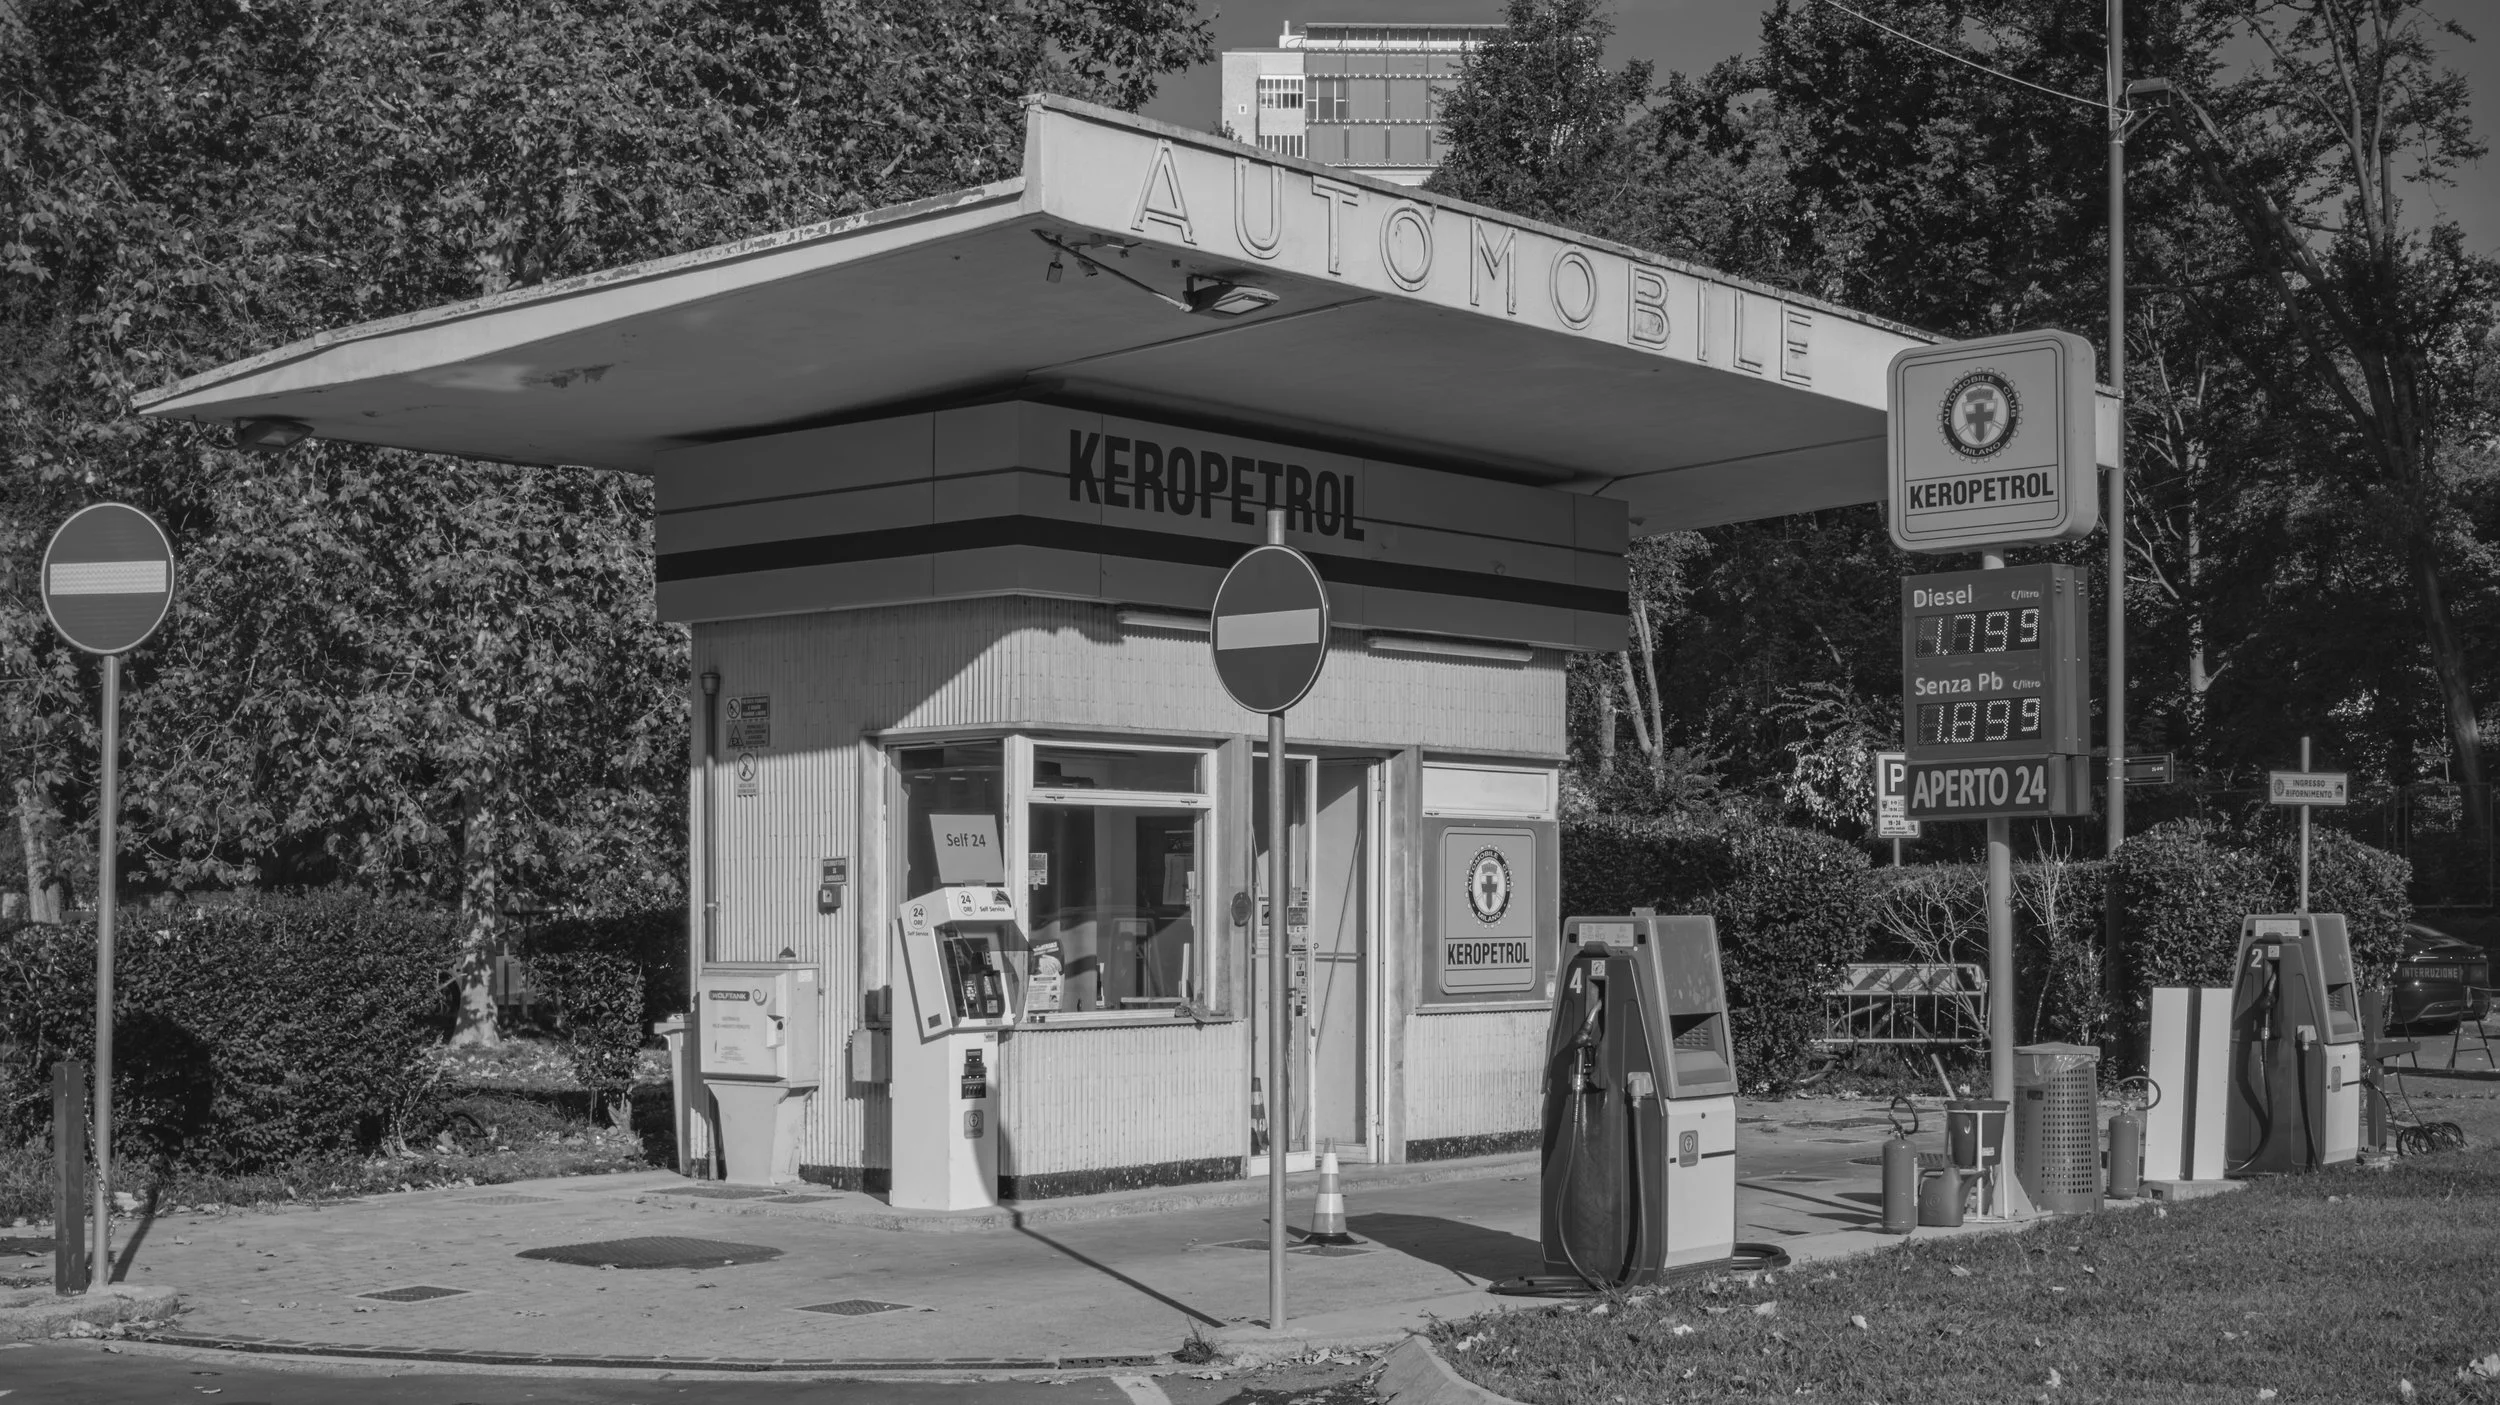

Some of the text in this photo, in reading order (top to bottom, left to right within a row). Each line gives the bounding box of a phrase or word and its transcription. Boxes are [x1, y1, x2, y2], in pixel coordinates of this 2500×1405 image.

[1131, 138, 1815, 387] AUTOMOBILE
[1944, 374, 2017, 425] AUTOMOBILE CLUB
[1960, 441, 2001, 456] MILANO
[1068, 428, 1366, 542] KEROPETROL
[1909, 471, 2055, 510] KEROPETROL
[1913, 584, 2039, 608] Diesel €/litro
[1934, 608, 2040, 656] 1.799
[1915, 671, 2041, 697] Senza Pb €/litro
[1935, 698, 2041, 744] 1.899
[1890, 763, 1905, 792] P
[1912, 765, 2047, 808] APERTO 24
[2292, 779, 2326, 788] INGRESSO
[2285, 789, 2332, 798] RIFORNIMENTO
[946, 833, 986, 847] Self 24
[961, 895, 971, 904] 24
[913, 908, 924, 918] 24
[1446, 939, 1531, 966] KEROPETROL
[2250, 948, 2263, 968] 2
[1569, 967, 1582, 994] 4
[2401, 967, 2459, 979] INTERRUZIONE
